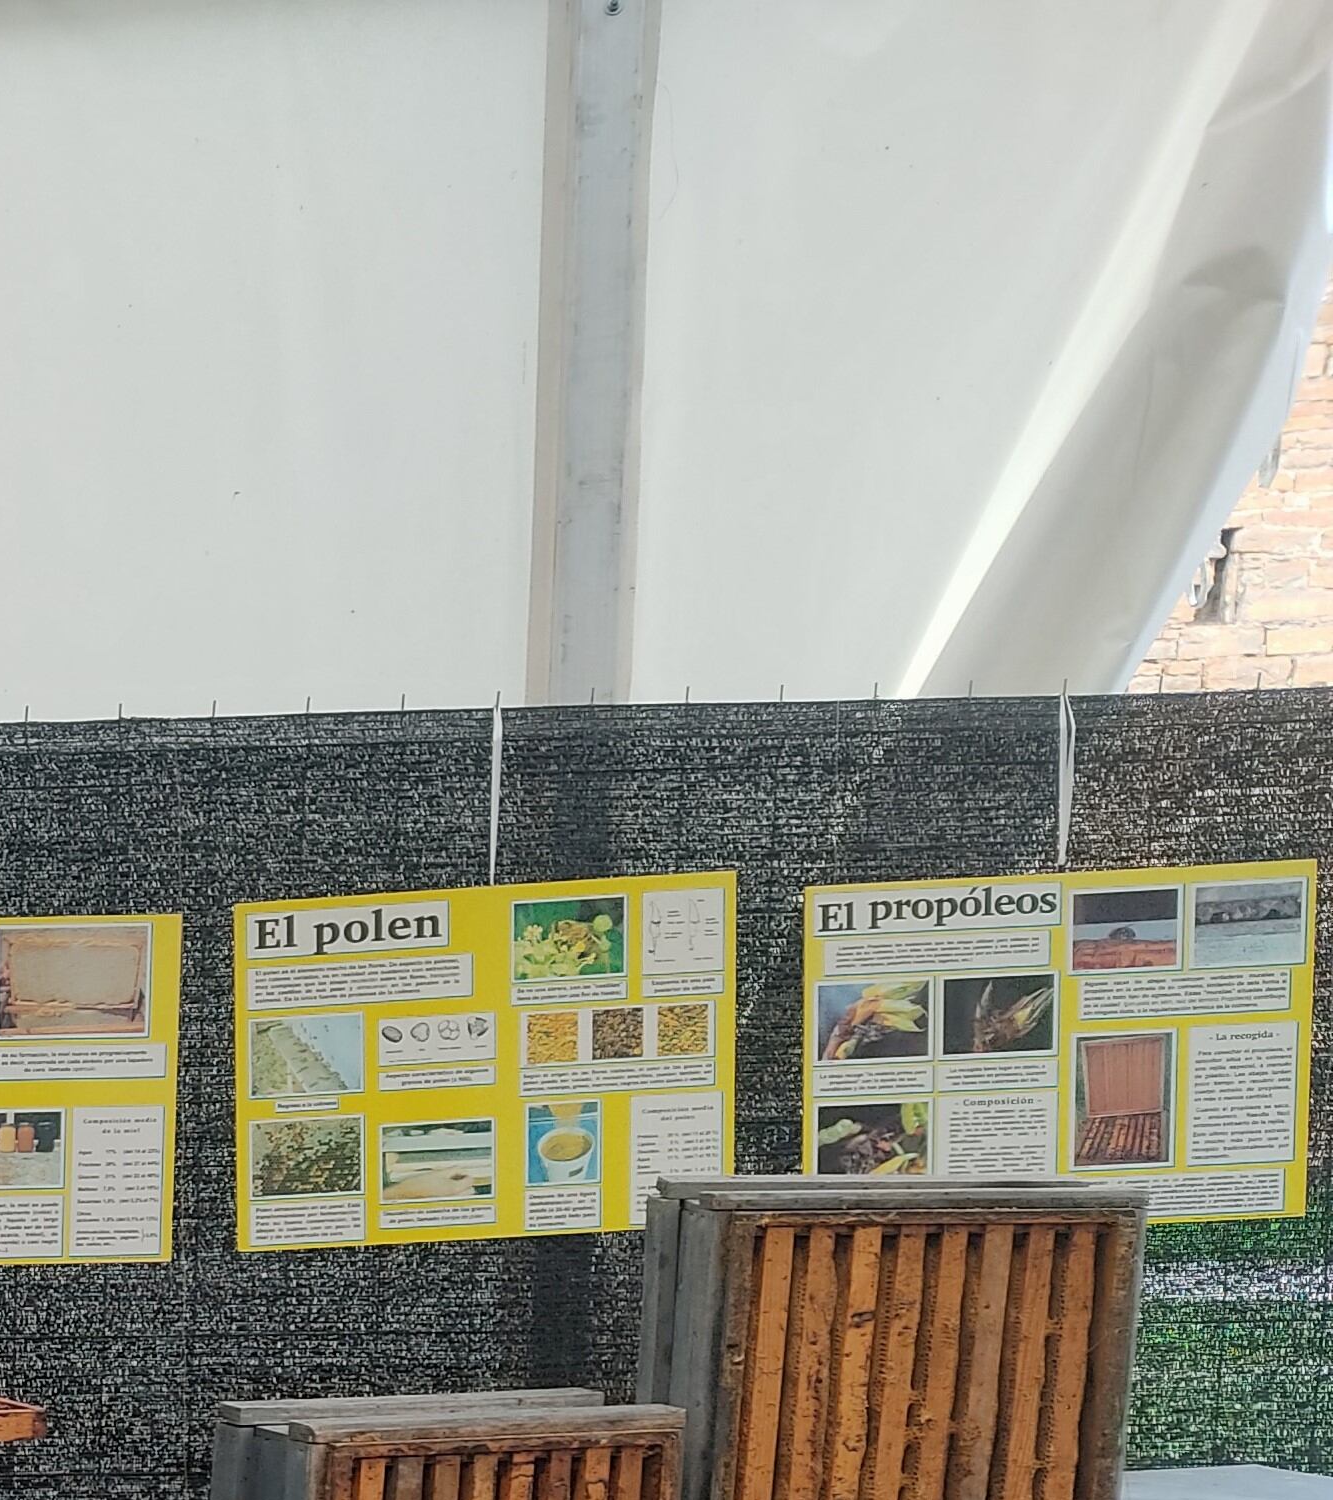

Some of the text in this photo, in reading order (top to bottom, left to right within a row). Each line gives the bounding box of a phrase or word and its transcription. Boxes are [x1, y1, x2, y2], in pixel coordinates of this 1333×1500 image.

[819, 885, 1058, 932] El propóleos
[253, 908, 443, 954] El polen
[1216, 1030, 1274, 1041] La recogida
[963, 1096, 1034, 1107] Composición
